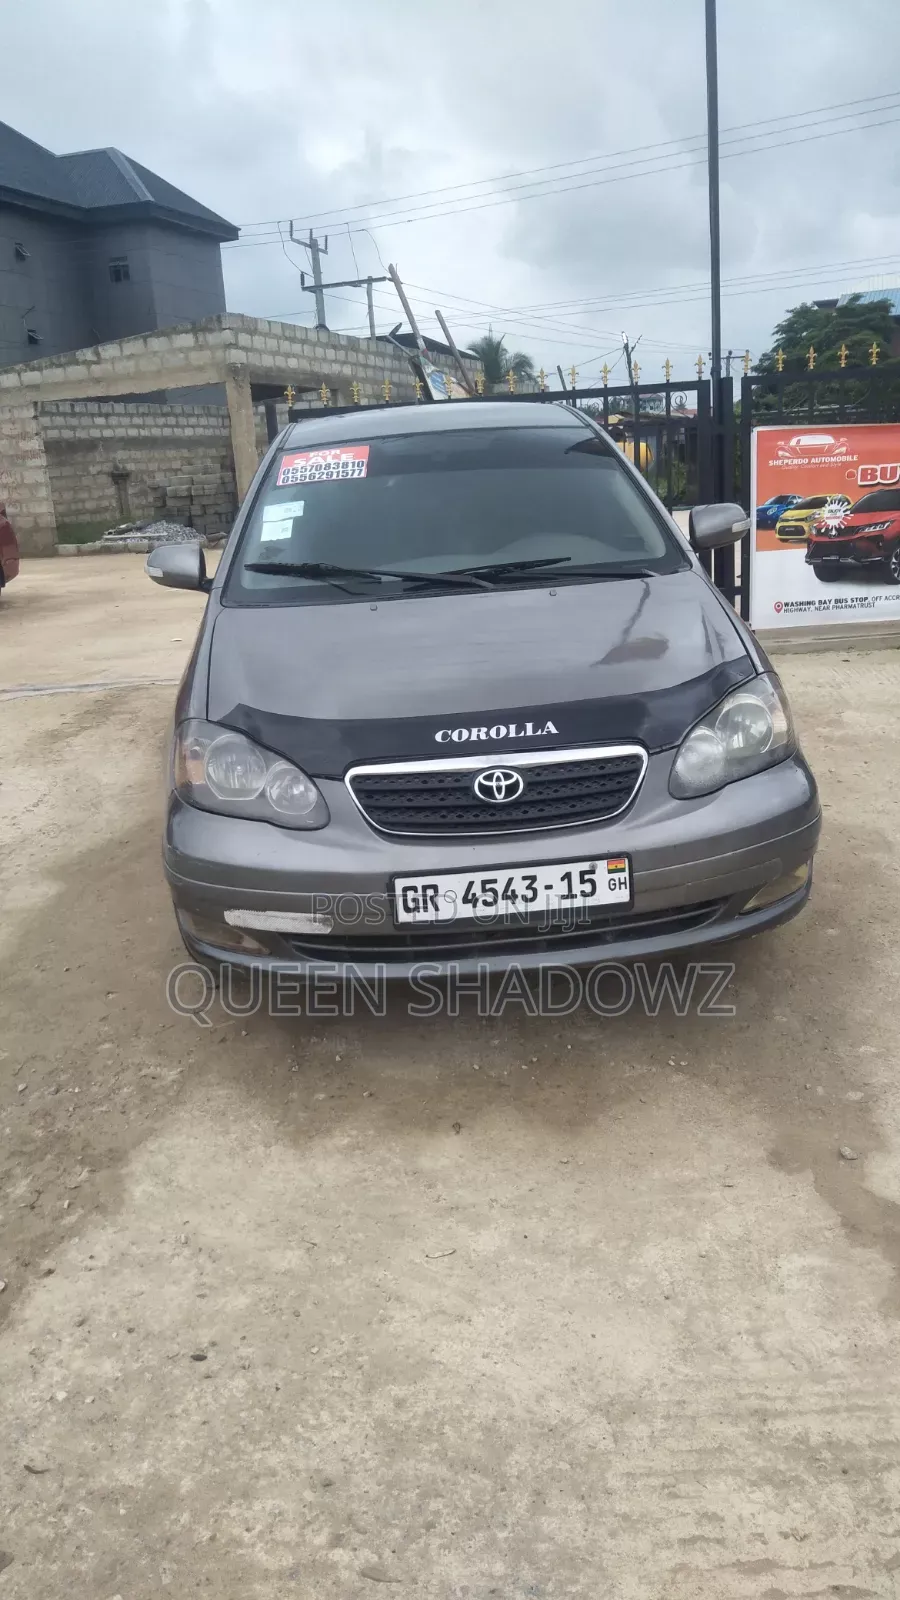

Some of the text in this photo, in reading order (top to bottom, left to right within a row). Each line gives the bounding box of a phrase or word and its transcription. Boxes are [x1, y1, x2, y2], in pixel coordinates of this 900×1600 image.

[294, 453, 354, 465] SALE
[310, 449, 340, 457] FOR
[769, 455, 858, 466] SHEPERDO AUTOMOBILE
[282, 468, 363, 484] 0556291577
[283, 460, 364, 476] 0557083810
[858, 463, 900, 485] BU
[832, 602, 875, 611] PHARMATRUST
[435, 721, 559, 742] COROLLA
[401, 884, 440, 914] GR
[608, 877, 628, 891] GH
